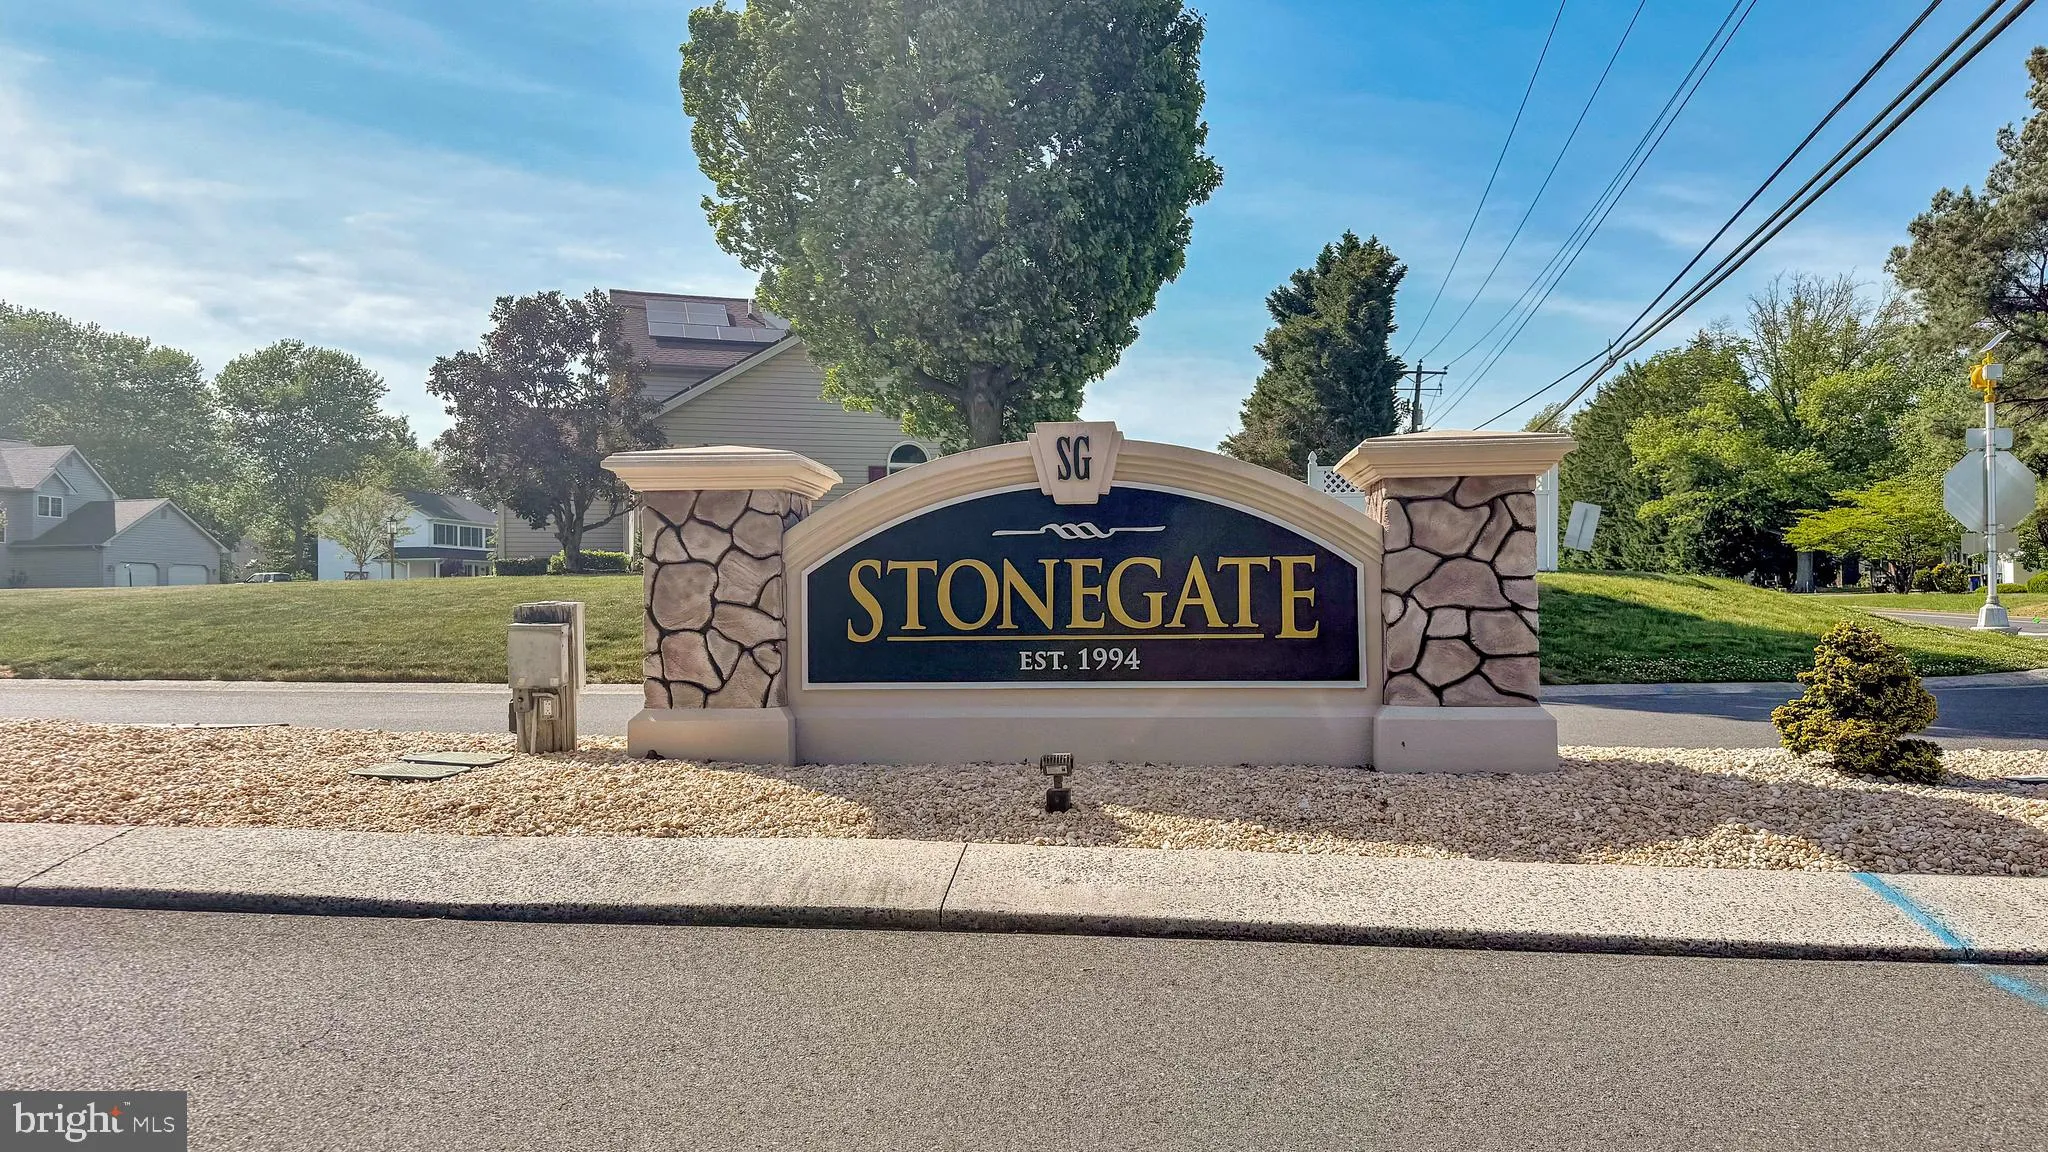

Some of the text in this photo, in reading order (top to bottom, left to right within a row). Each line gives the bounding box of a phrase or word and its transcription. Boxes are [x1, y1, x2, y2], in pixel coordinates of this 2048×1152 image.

[1056, 435, 1092, 481] SG
[846, 554, 1319, 643] STONEGATE
[1019, 647, 1140, 671] EST. 1994
